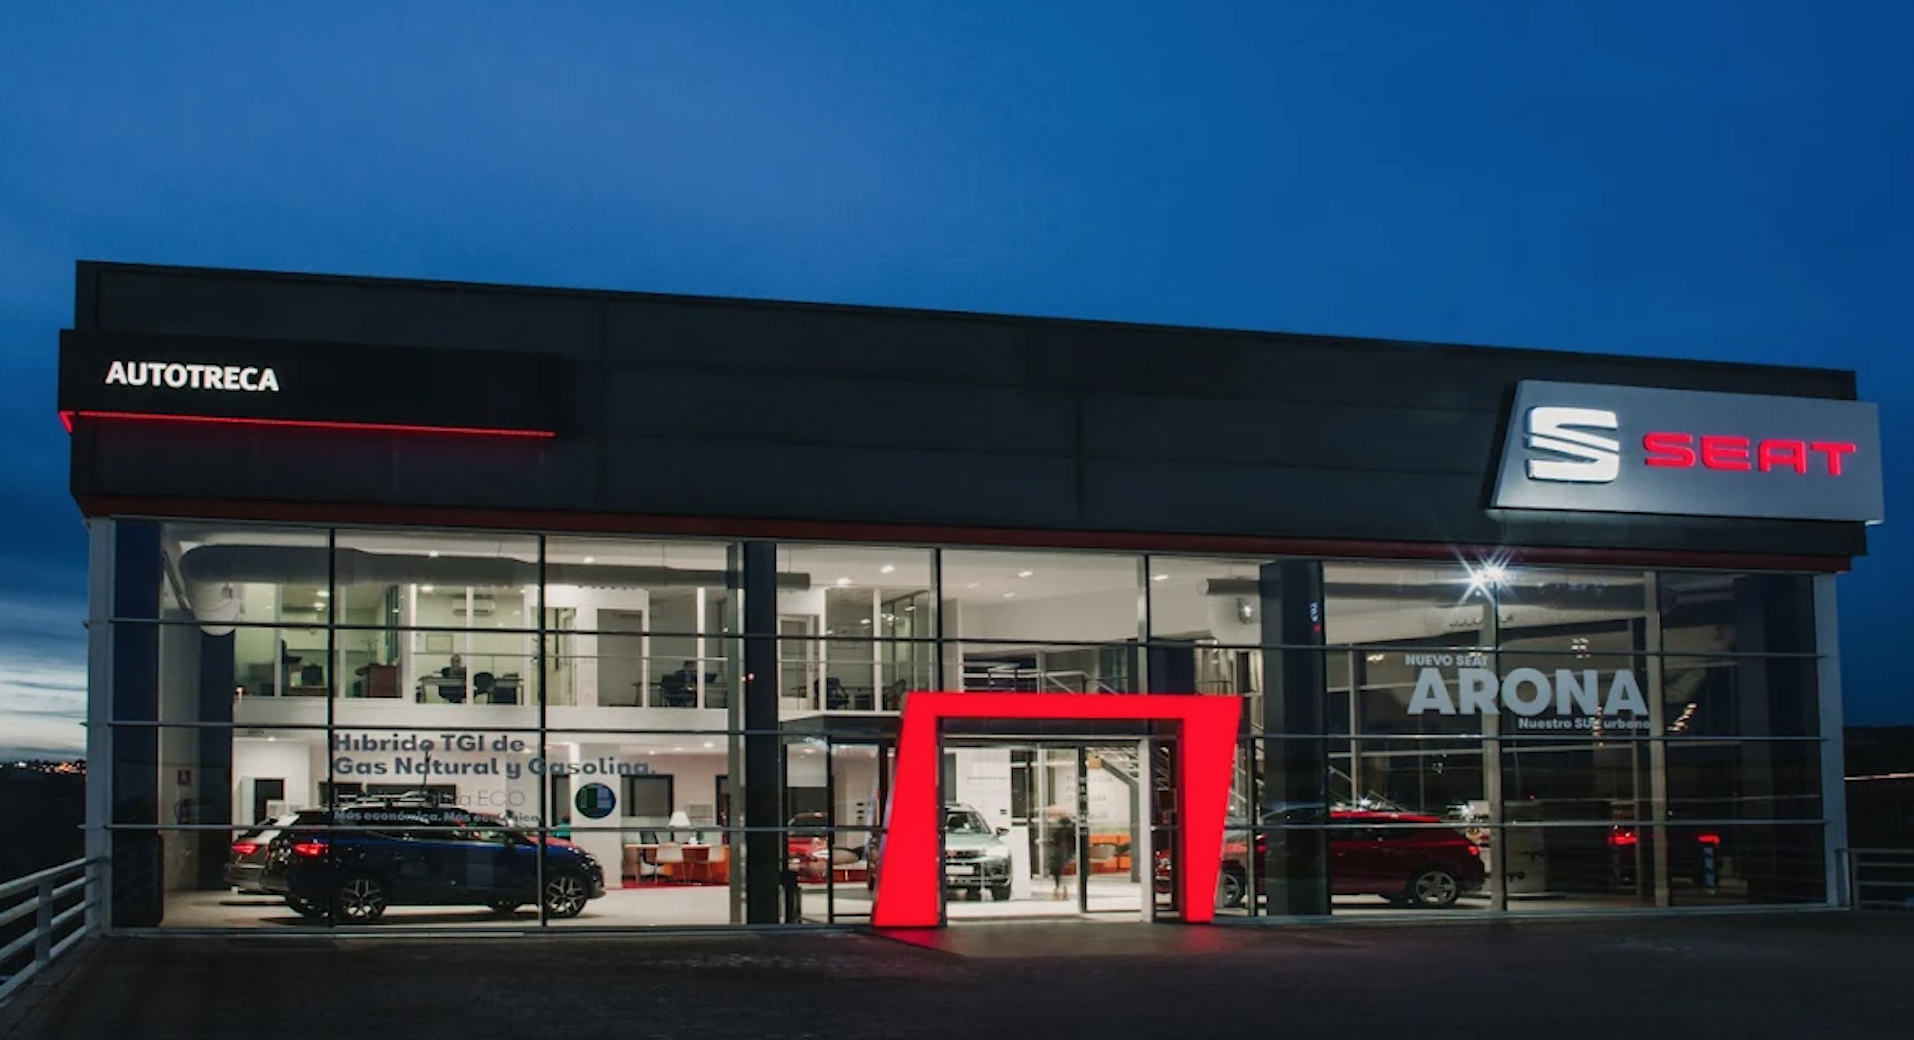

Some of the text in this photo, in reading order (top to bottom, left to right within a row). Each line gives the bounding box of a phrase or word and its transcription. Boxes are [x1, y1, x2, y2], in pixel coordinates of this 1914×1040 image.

[105, 360, 280, 392] AUTOTRECA
[1643, 432, 1857, 476] SEAT
[1405, 654, 1489, 666] NUEVO SEAT
[1407, 667, 1649, 716] ARONA
[1518, 717, 1651, 730] Nuestro SU urbano
[441, 734, 485, 752] TGI
[492, 734, 525, 752] de
[333, 756, 656, 780] Gas Natural y Gasolina.
[477, 789, 526, 807] ECO
